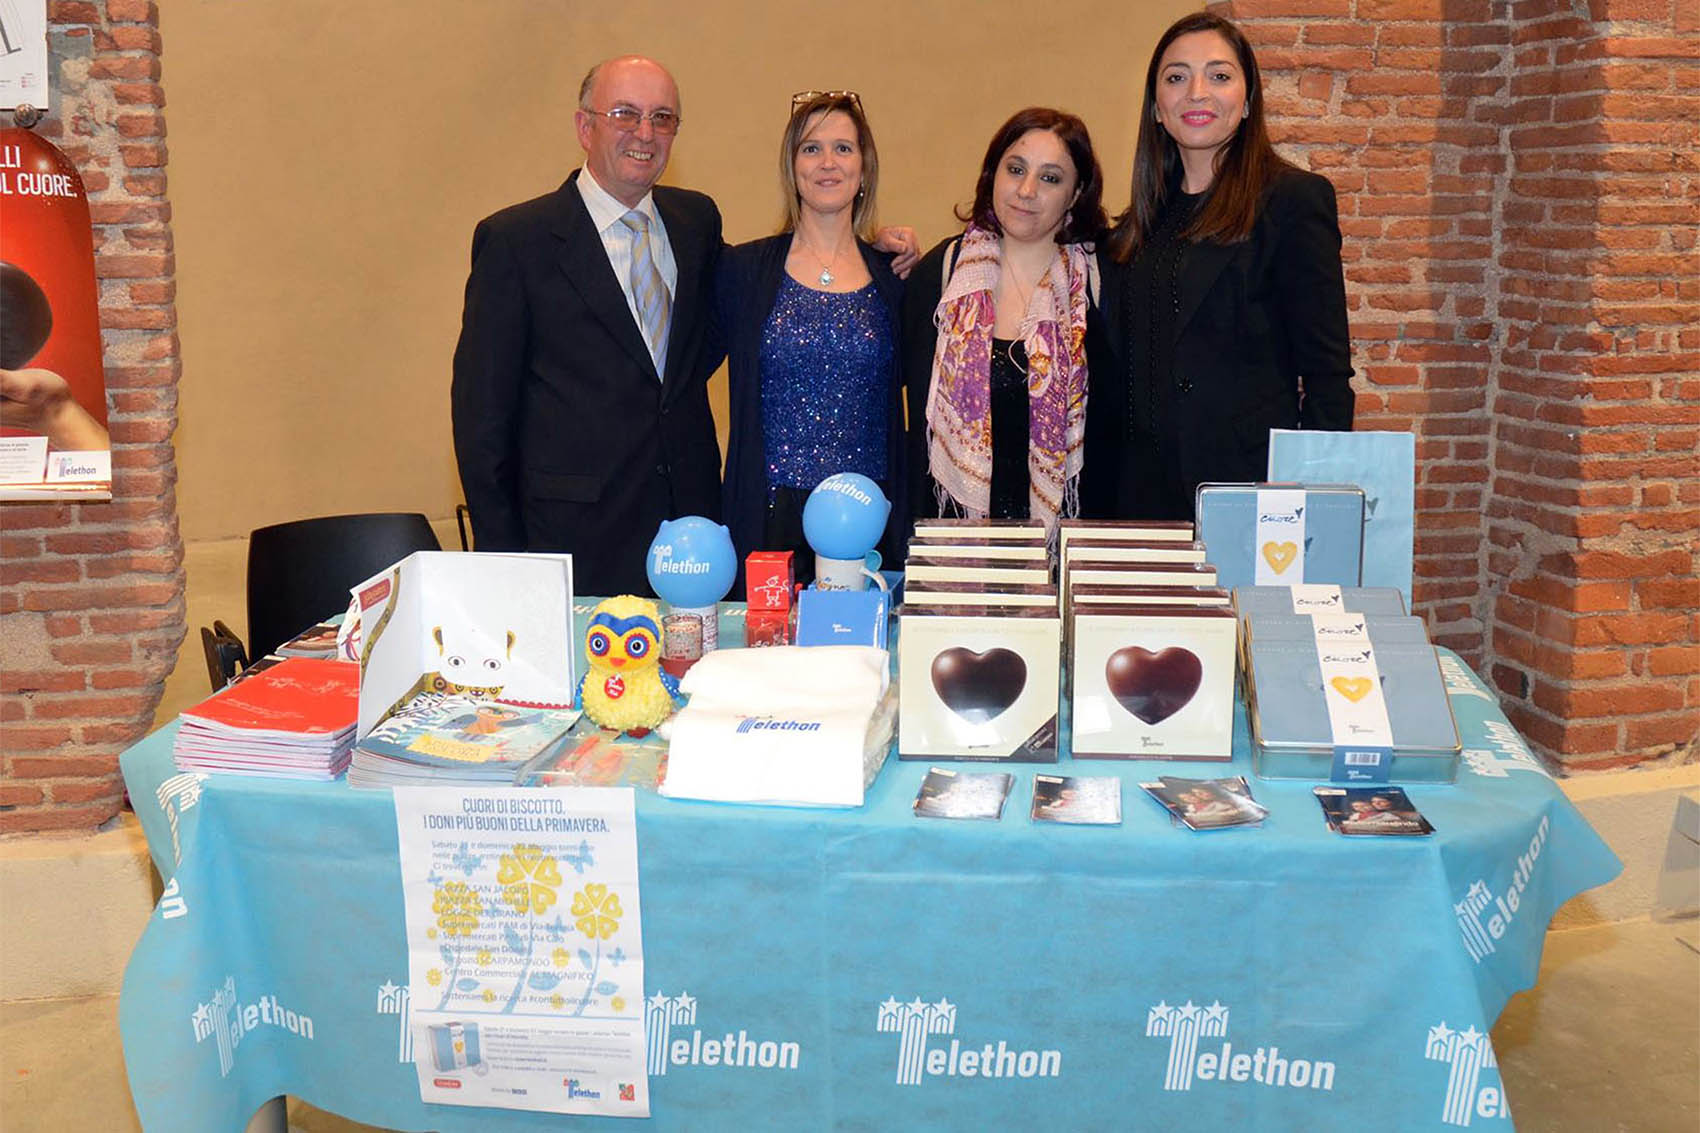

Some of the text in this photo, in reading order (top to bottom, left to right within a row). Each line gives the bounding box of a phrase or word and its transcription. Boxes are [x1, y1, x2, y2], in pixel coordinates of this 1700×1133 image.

[0, 145, 20, 168] LI
[0, 172, 77, 197] L CUORE.
[55, 457, 97, 477] Telethon
[813, 473, 872, 505] Telethon
[653, 545, 710, 575] Telethon
[734, 715, 821, 734] Telethon
[462, 798, 566, 816] CUORI DI BISCOTTO.
[424, 813, 611, 833] I DONI PIÙ BUONI DELLA PRIMAVERA.
[473, 884, 491, 893] SAN
[1453, 815, 1551, 964] Telethon
[192, 976, 314, 1078] Telethon
[644, 990, 800, 1076] Telethon
[876, 995, 1062, 1085] Telethon
[1145, 999, 1335, 1092] Telethon
[563, 1075, 601, 1099] Telethon
